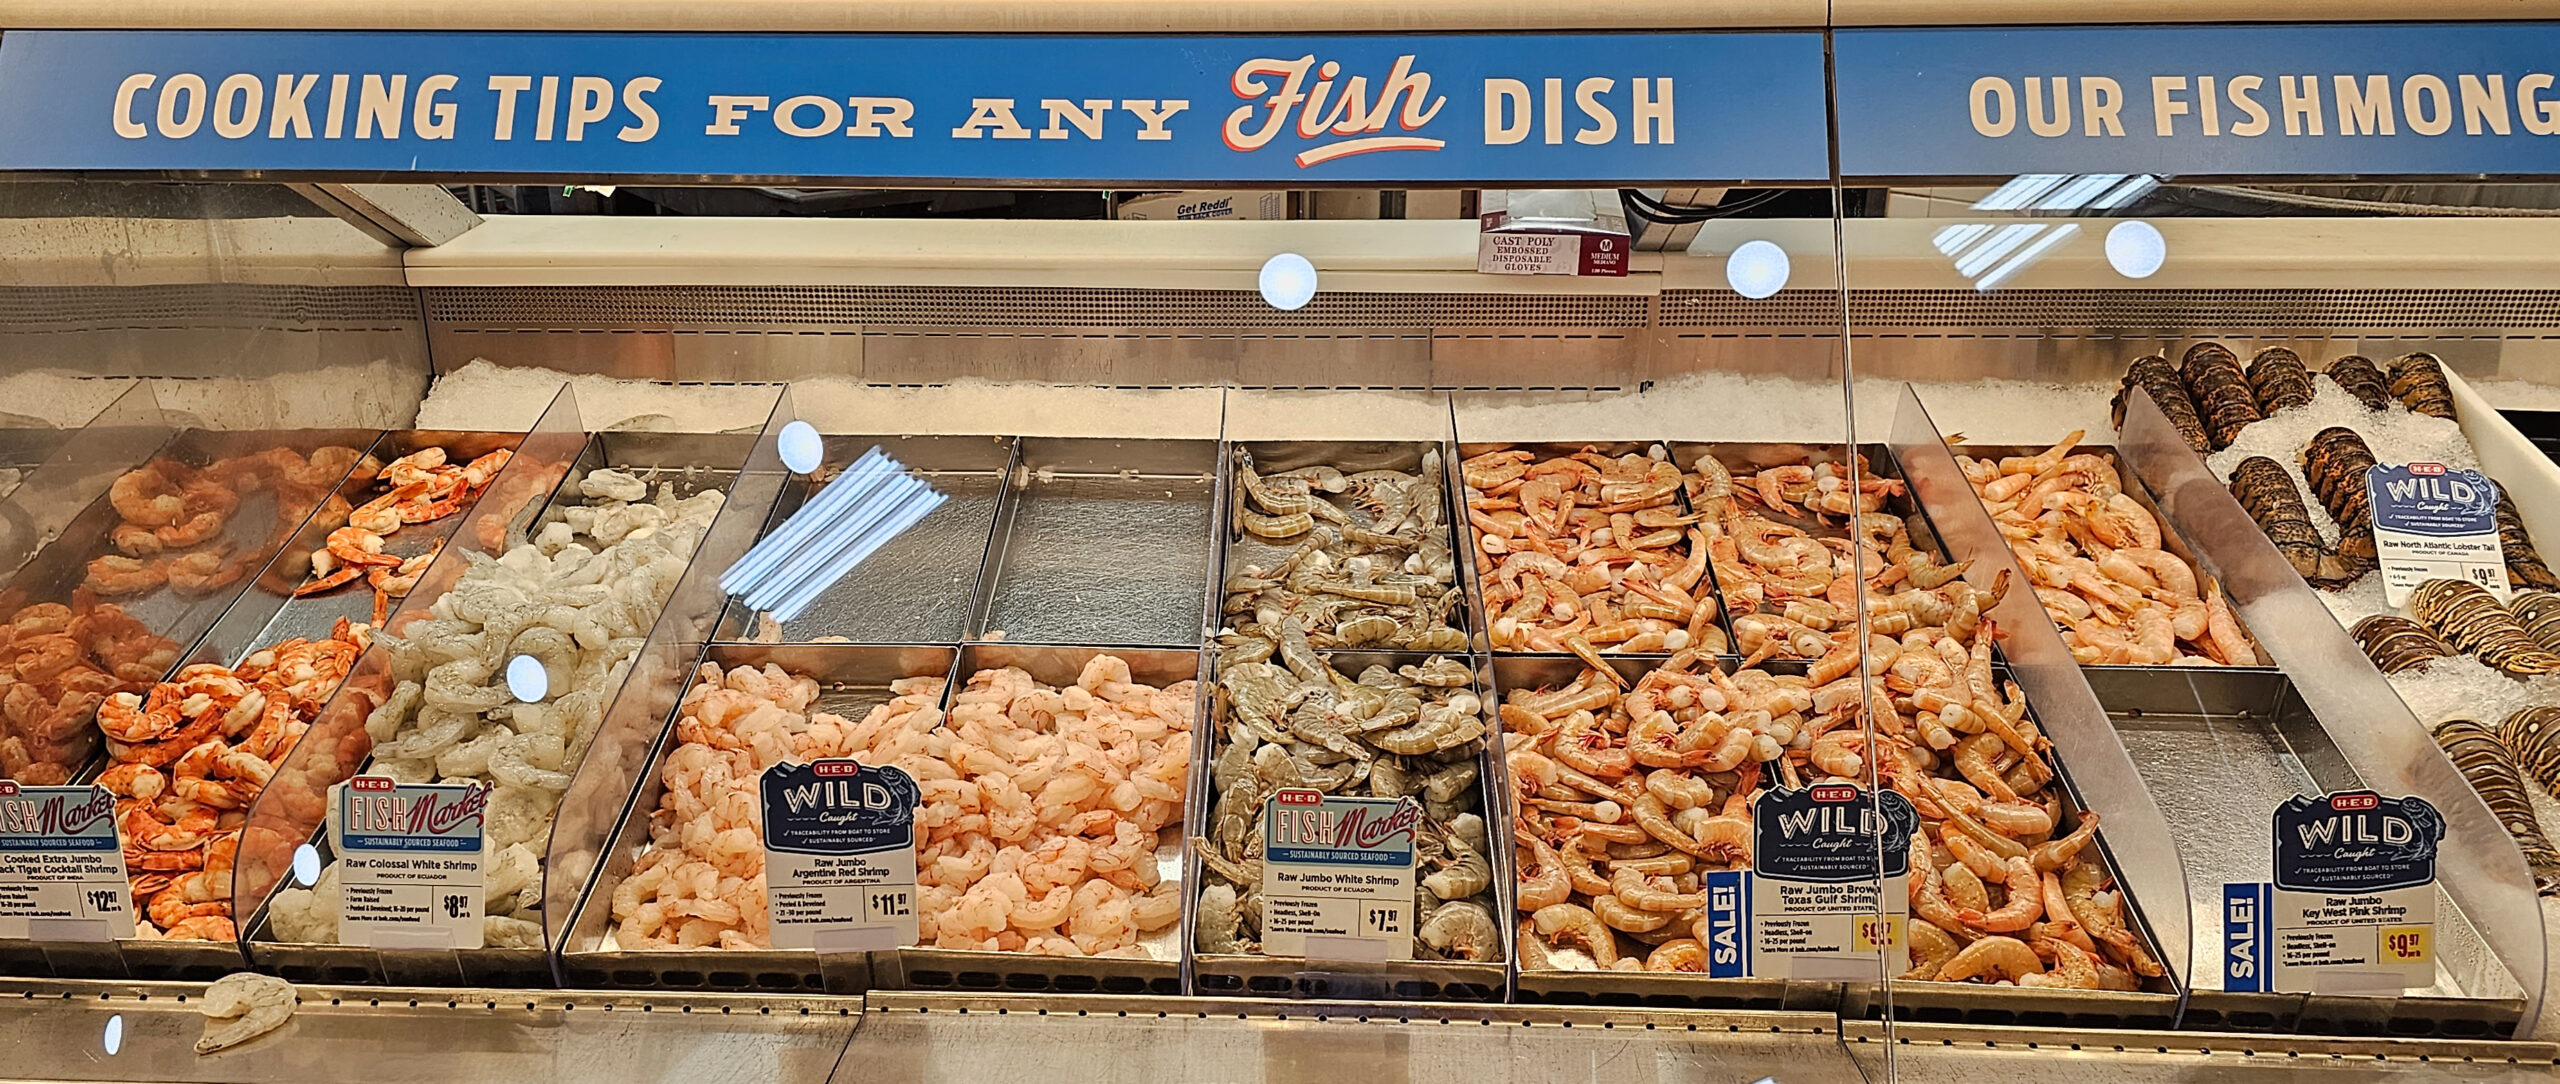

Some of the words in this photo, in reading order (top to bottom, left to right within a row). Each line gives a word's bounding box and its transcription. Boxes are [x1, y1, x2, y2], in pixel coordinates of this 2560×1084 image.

[112, 73, 459, 141] COOKING
[489, 75, 663, 143] TIPS
[705, 95, 914, 138] FOR
[952, 98, 1189, 141] ANY
[1221, 54, 1446, 153] Fish
[1484, 76, 1674, 146] DISH
[1969, 75, 2126, 138] OUR
[2151, 73, 2560, 137] FISHMONG
[1177, 204, 1196, 214] Get
[1493, 236, 1522, 245] CAST
[1527, 237, 1555, 246] POLY
[1497, 246, 1549, 254] EMBOSSED
[1492, 254, 1552, 263] DISPOSABLE
[1504, 263, 1541, 271] GLOVES
[2386, 478, 2476, 503] WILD
[2417, 502, 2449, 514] Caught
[783, 781, 892, 814] WILD
[37, 784, 115, 836] Market
[350, 796, 407, 831] FISH
[405, 781, 494, 835] Market
[819, 811, 858, 826] Caught
[1276, 810, 1335, 845] FISH
[1333, 798, 1421, 848] Market
[1778, 806, 1889, 839] WILD
[2297, 815, 2413, 850] WILD
[364, 838, 404, 847] SUSTAINABLY
[404, 838, 431, 847] SOURCED
[432, 838, 459, 847] SEAFOOD
[1812, 837, 1853, 852] Caught
[4, 855, 40, 863] Cooked
[42, 855, 67, 863] Extra
[70, 855, 102, 863] Jumbo
[1290, 851, 1330, 859] SUSTAINABLY
[1331, 852, 1359, 861] SOURCED
[1360, 853, 1388, 861] SEAFOOD
[2333, 847, 2376, 862] Caught
[17, 865, 41, 874] Tiger
[44, 865, 82, 874] Cocktail
[84, 865, 118, 874] Shrimp
[346, 859, 366, 869] Raw
[369, 859, 410, 869] Colossal
[411, 859, 441, 870] White
[443, 861, 477, 872] Shrimp
[814, 858, 834, 868] Raw
[835, 858, 866, 867] Jumbo
[792, 868, 836, 879] Argentine
[838, 868, 856, 877] Red
[858, 868, 890, 878] Shrimp
[1277, 872, 1297, 882] Raw
[1299, 873, 1332, 883] Jumbo
[1334, 874, 1363, 884] White
[1365, 874, 1399, 886] Shrimp
[1780, 886, 1803, 895] Raw
[1806, 885, 1843, 894] Jumbo
[1782, 895, 1812, 904] Texas
[1815, 895, 1838, 904] Gulf
[2326, 898, 2346, 906] Raw
[2349, 896, 2382, 905] Jumbo
[2302, 909, 2320, 919] Key
[2322, 908, 2347, 917] West
[2349, 907, 2370, 916] Pink
[2372, 905, 2406, 916] Shrimp
[1712, 885, 1737, 964] SALE!
[2230, 897, 2254, 979] SALE!
